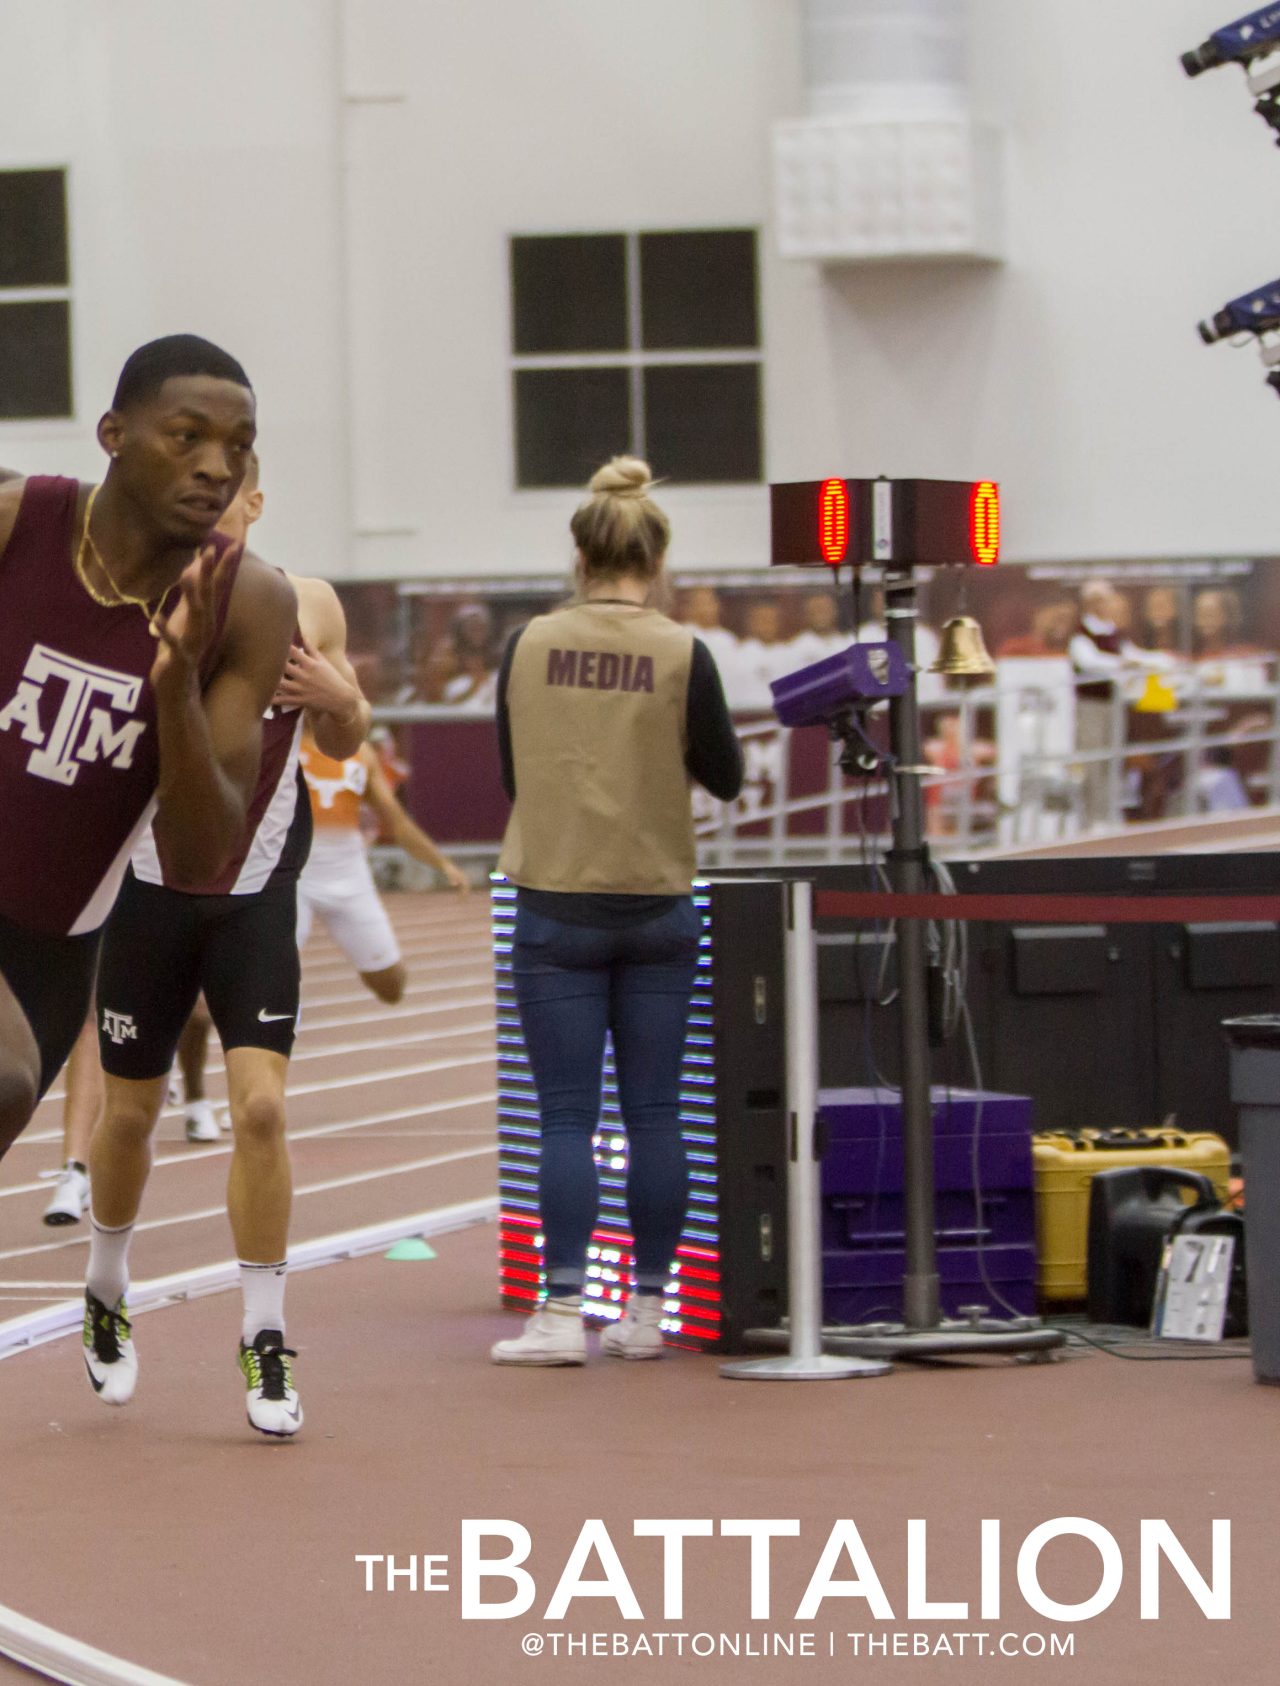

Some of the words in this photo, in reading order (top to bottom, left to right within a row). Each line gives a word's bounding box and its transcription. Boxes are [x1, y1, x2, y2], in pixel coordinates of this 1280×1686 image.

[822, 480, 848, 563] 0
[972, 481, 1000, 564] 0
[546, 648, 655, 693] MEDIA
